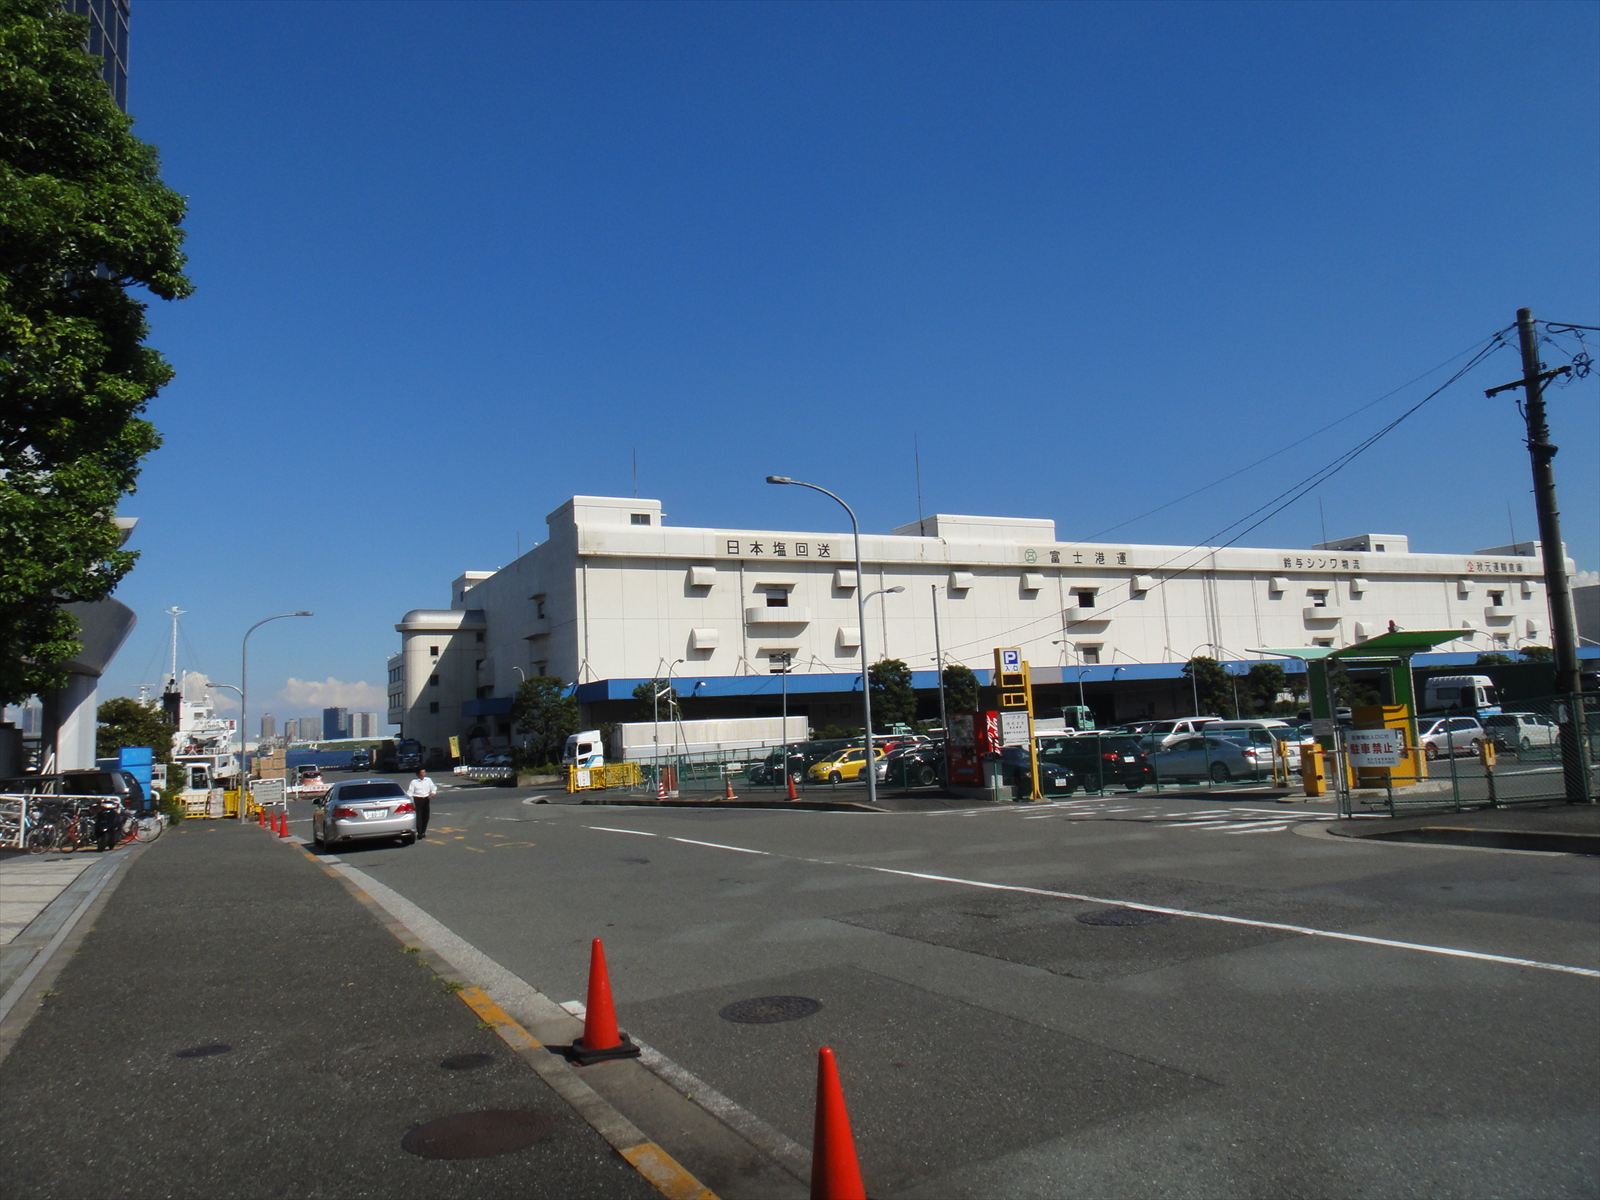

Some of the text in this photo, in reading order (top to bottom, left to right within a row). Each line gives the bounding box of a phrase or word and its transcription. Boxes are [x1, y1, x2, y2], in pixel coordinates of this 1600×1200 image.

[727, 540, 830, 558] 日本塩回送
[1049, 550, 1127, 565] 富士港運
[1005, 652, 1016, 664] P
[1350, 742, 1394, 754] 駐車禁止
